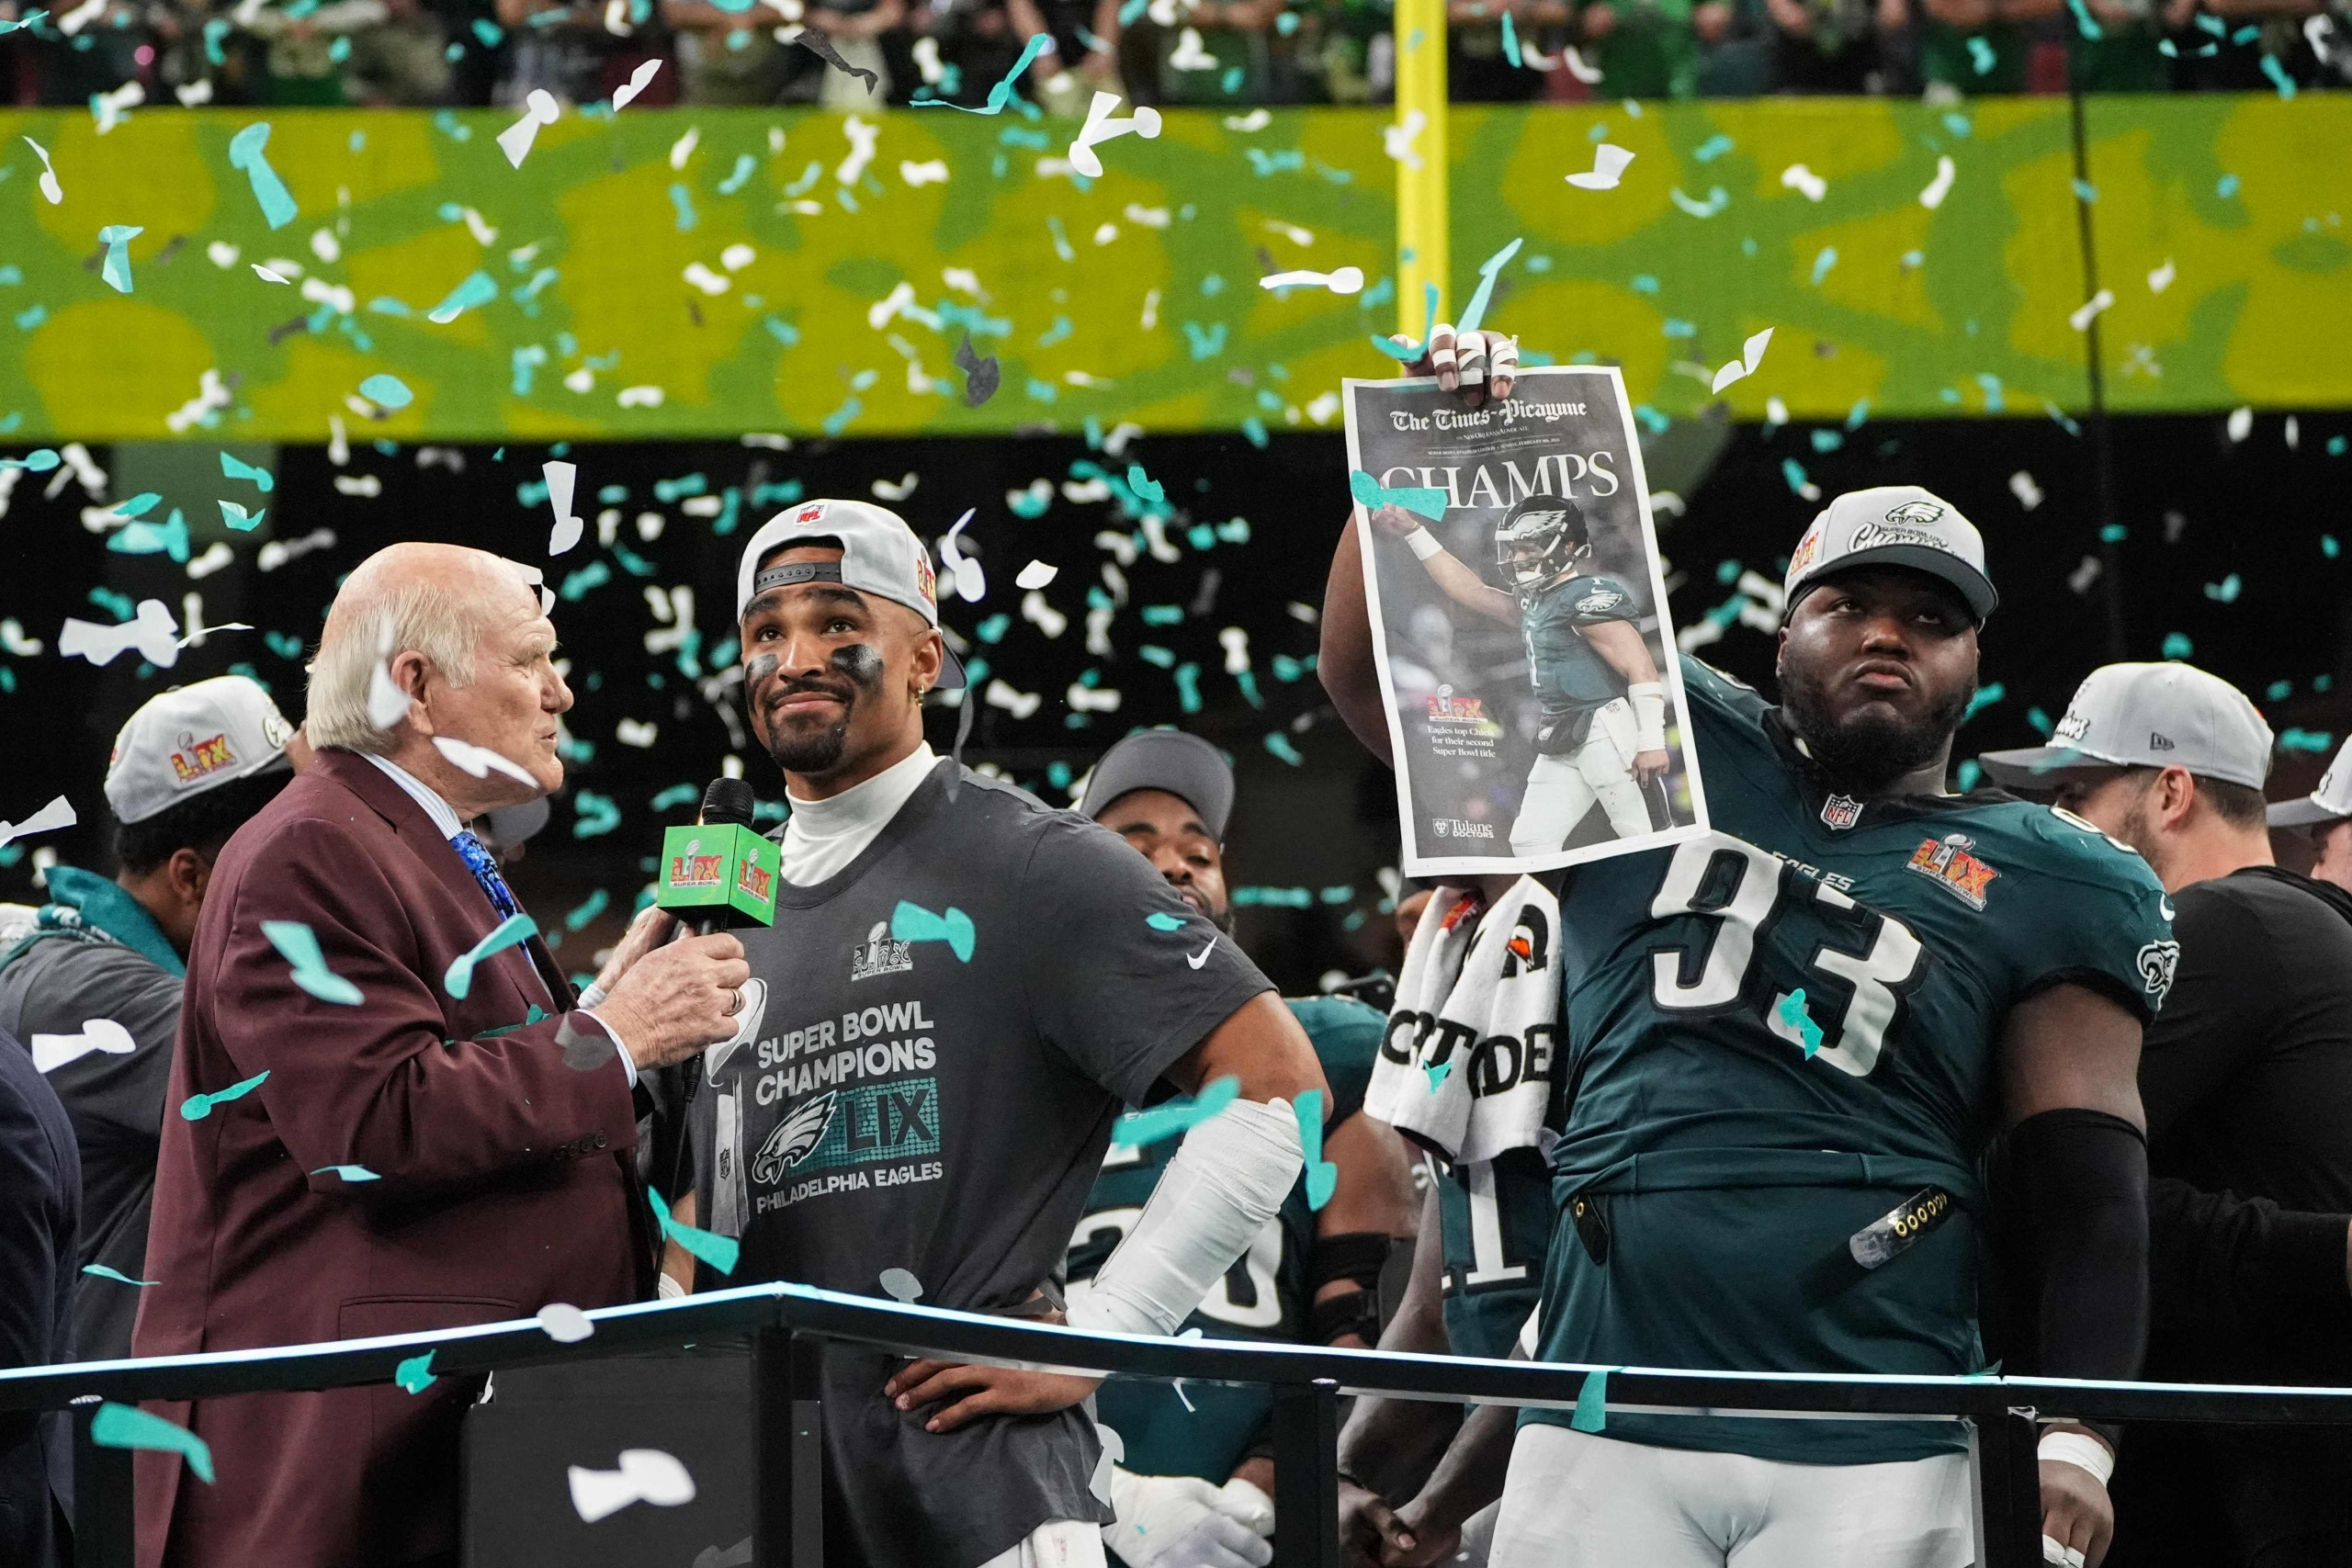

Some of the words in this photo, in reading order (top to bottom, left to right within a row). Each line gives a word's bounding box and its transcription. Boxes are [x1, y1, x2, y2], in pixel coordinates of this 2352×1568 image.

[1389, 411, 1430, 432] The
[1432, 398, 1588, 431] Times-Picayune
[1427, 726, 1453, 735] Eagles
[1454, 728, 1468, 737] top
[1431, 736, 1443, 744] for
[1445, 737, 1464, 746] their
[1433, 747, 1456, 756] Super
[1458, 748, 1478, 757] Bowl
[1480, 750, 1497, 758] title
[1449, 818, 1493, 832] Tulane
[1827, 806, 1850, 825] NFL
[740, 886, 754, 897] SUPER
[1917, 865, 1949, 884] SUPER
[1950, 880, 1973, 899] BOWL
[1651, 829, 1925, 1077] 93
[857, 969, 881, 978] SUPER
[758, 1020, 837, 1068] SUPER
[842, 1000, 934, 1042] BOWL
[755, 1037, 937, 1106] CHAMPIONS
[843, 1088, 937, 1154] LIX
[756, 1170, 870, 1214] PHILADELPHIA
[875, 1161, 944, 1187] EAGLES
